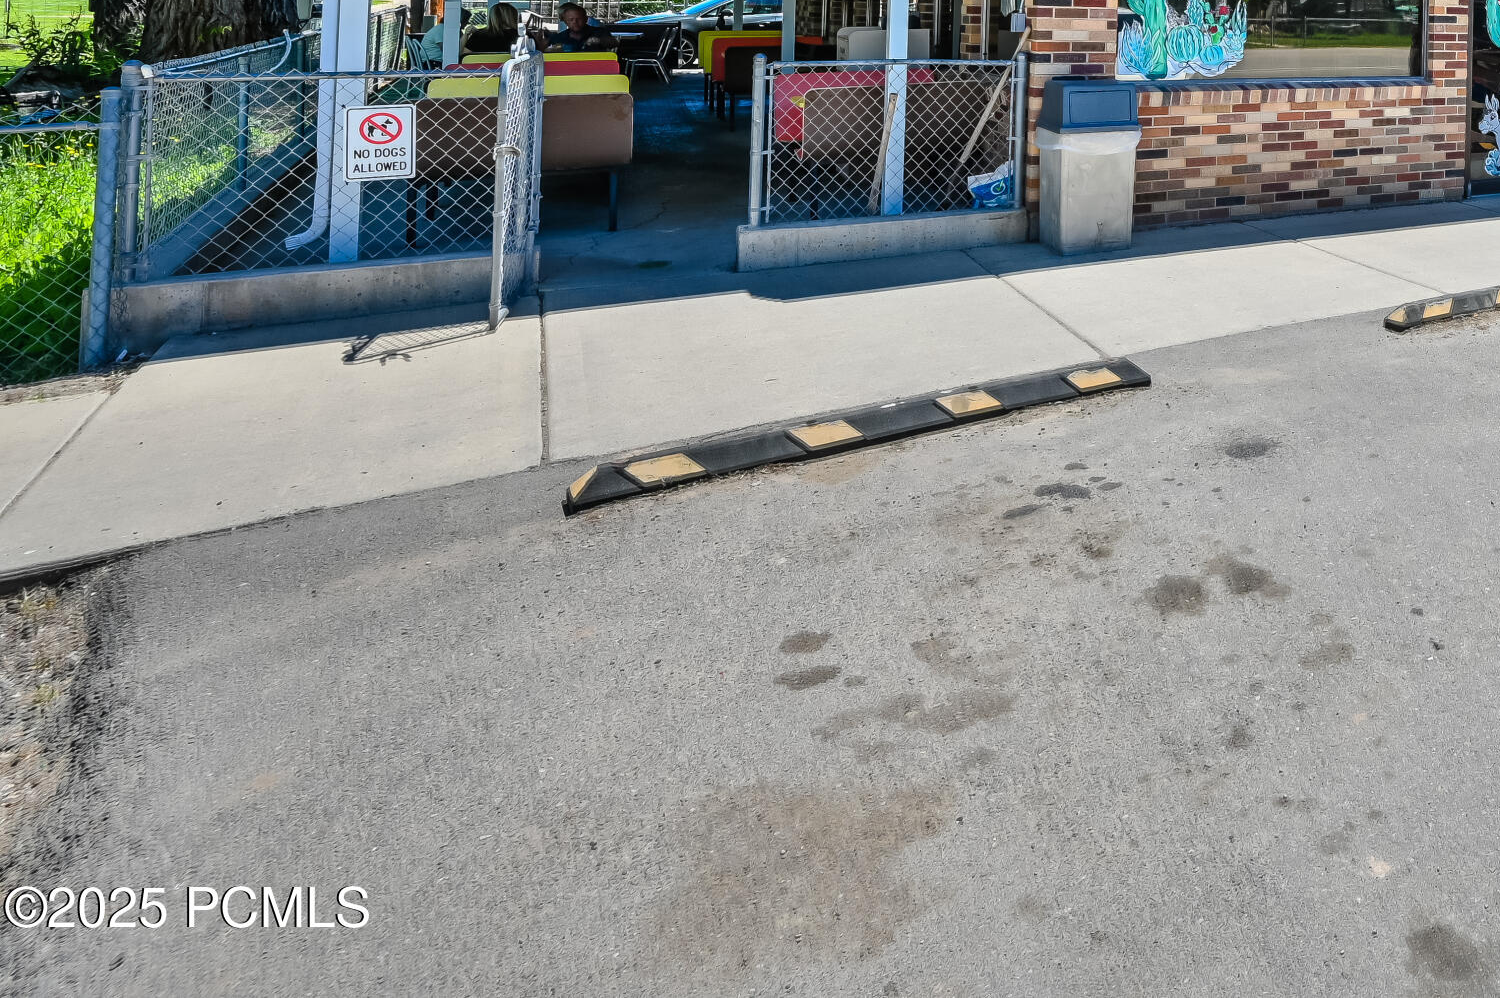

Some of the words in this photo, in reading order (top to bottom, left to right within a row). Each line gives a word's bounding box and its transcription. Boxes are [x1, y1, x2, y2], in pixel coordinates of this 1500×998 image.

[353, 149, 370, 160] NO
[374, 147, 407, 158] DOGS
[352, 161, 407, 174] ALLOWED
